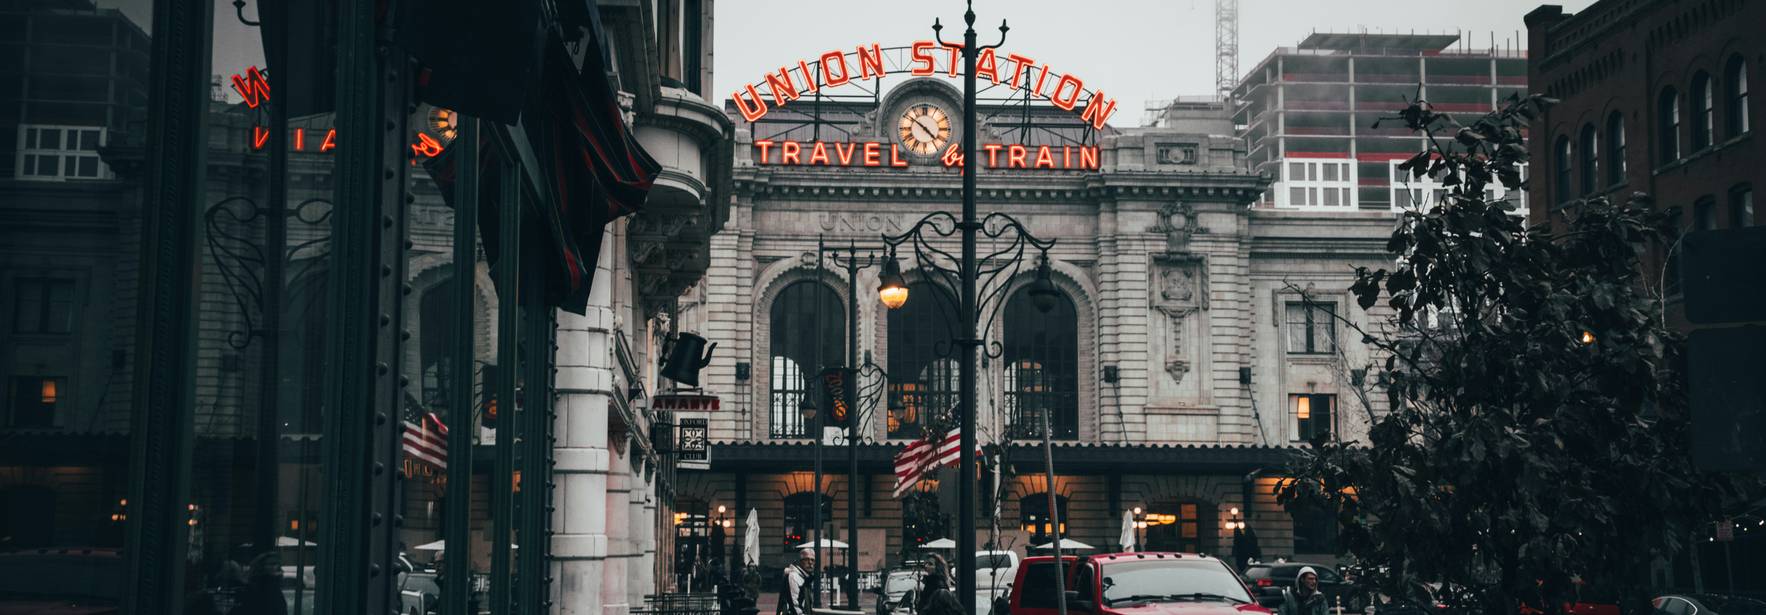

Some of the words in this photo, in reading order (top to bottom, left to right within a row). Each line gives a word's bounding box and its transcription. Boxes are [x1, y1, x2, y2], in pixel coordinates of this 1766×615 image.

[732, 42, 886, 122] UNION
[911, 41, 1116, 130] STATION
[754, 140, 909, 168] TRAVEL
[984, 143, 1099, 169] TRAIN
[819, 215, 904, 231] UNION
